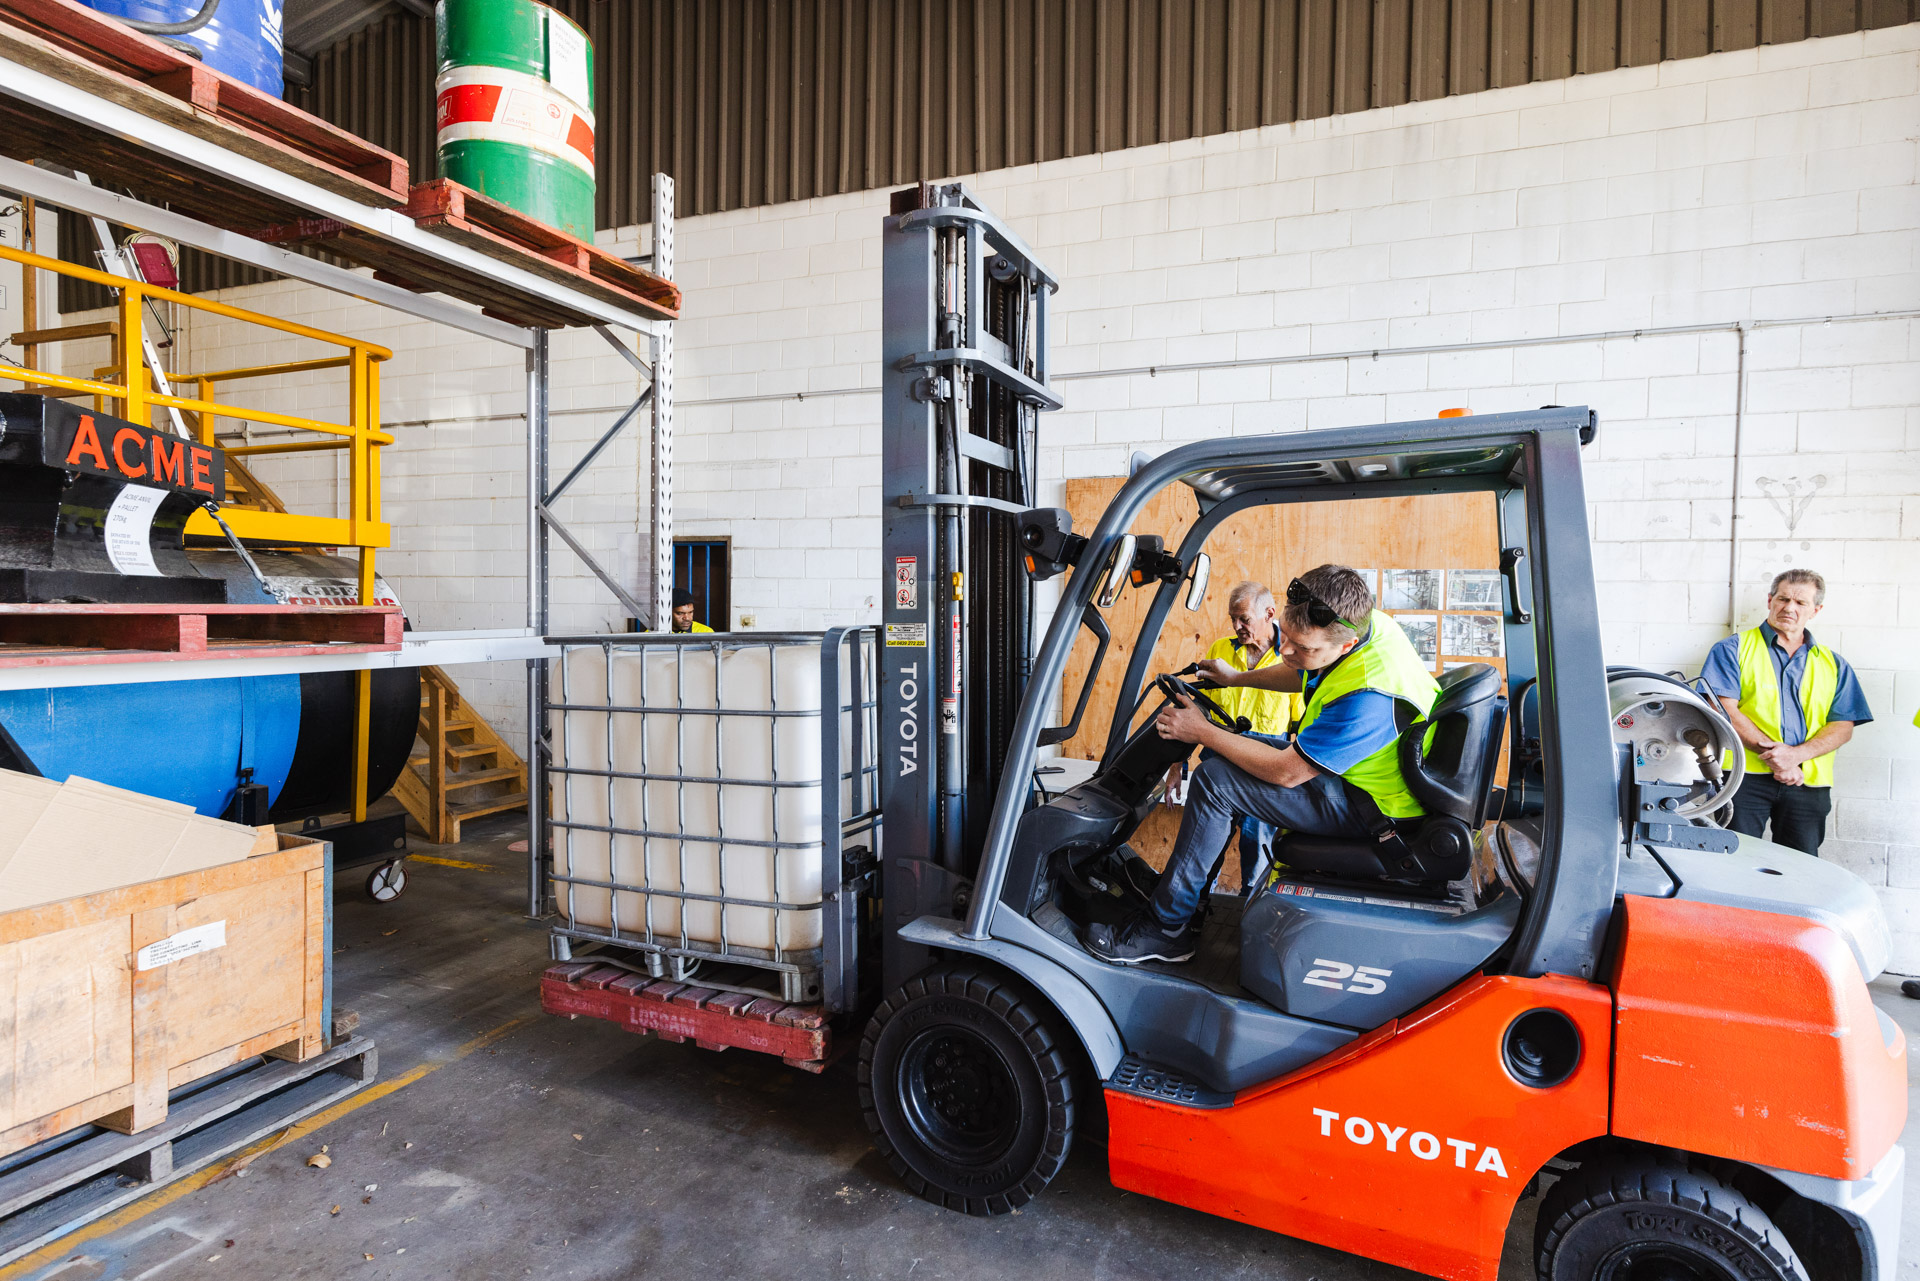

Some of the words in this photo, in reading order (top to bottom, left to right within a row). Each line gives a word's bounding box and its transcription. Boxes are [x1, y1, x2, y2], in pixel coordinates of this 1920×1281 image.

[66, 413, 215, 496] ACME
[121, 504, 139, 512] PALLET
[899, 662, 918, 777] TOYOTA
[1303, 957, 1393, 997] 25
[1312, 1107, 1509, 1179] TOYOTA
[1624, 1211, 1687, 1235] TOTAL
